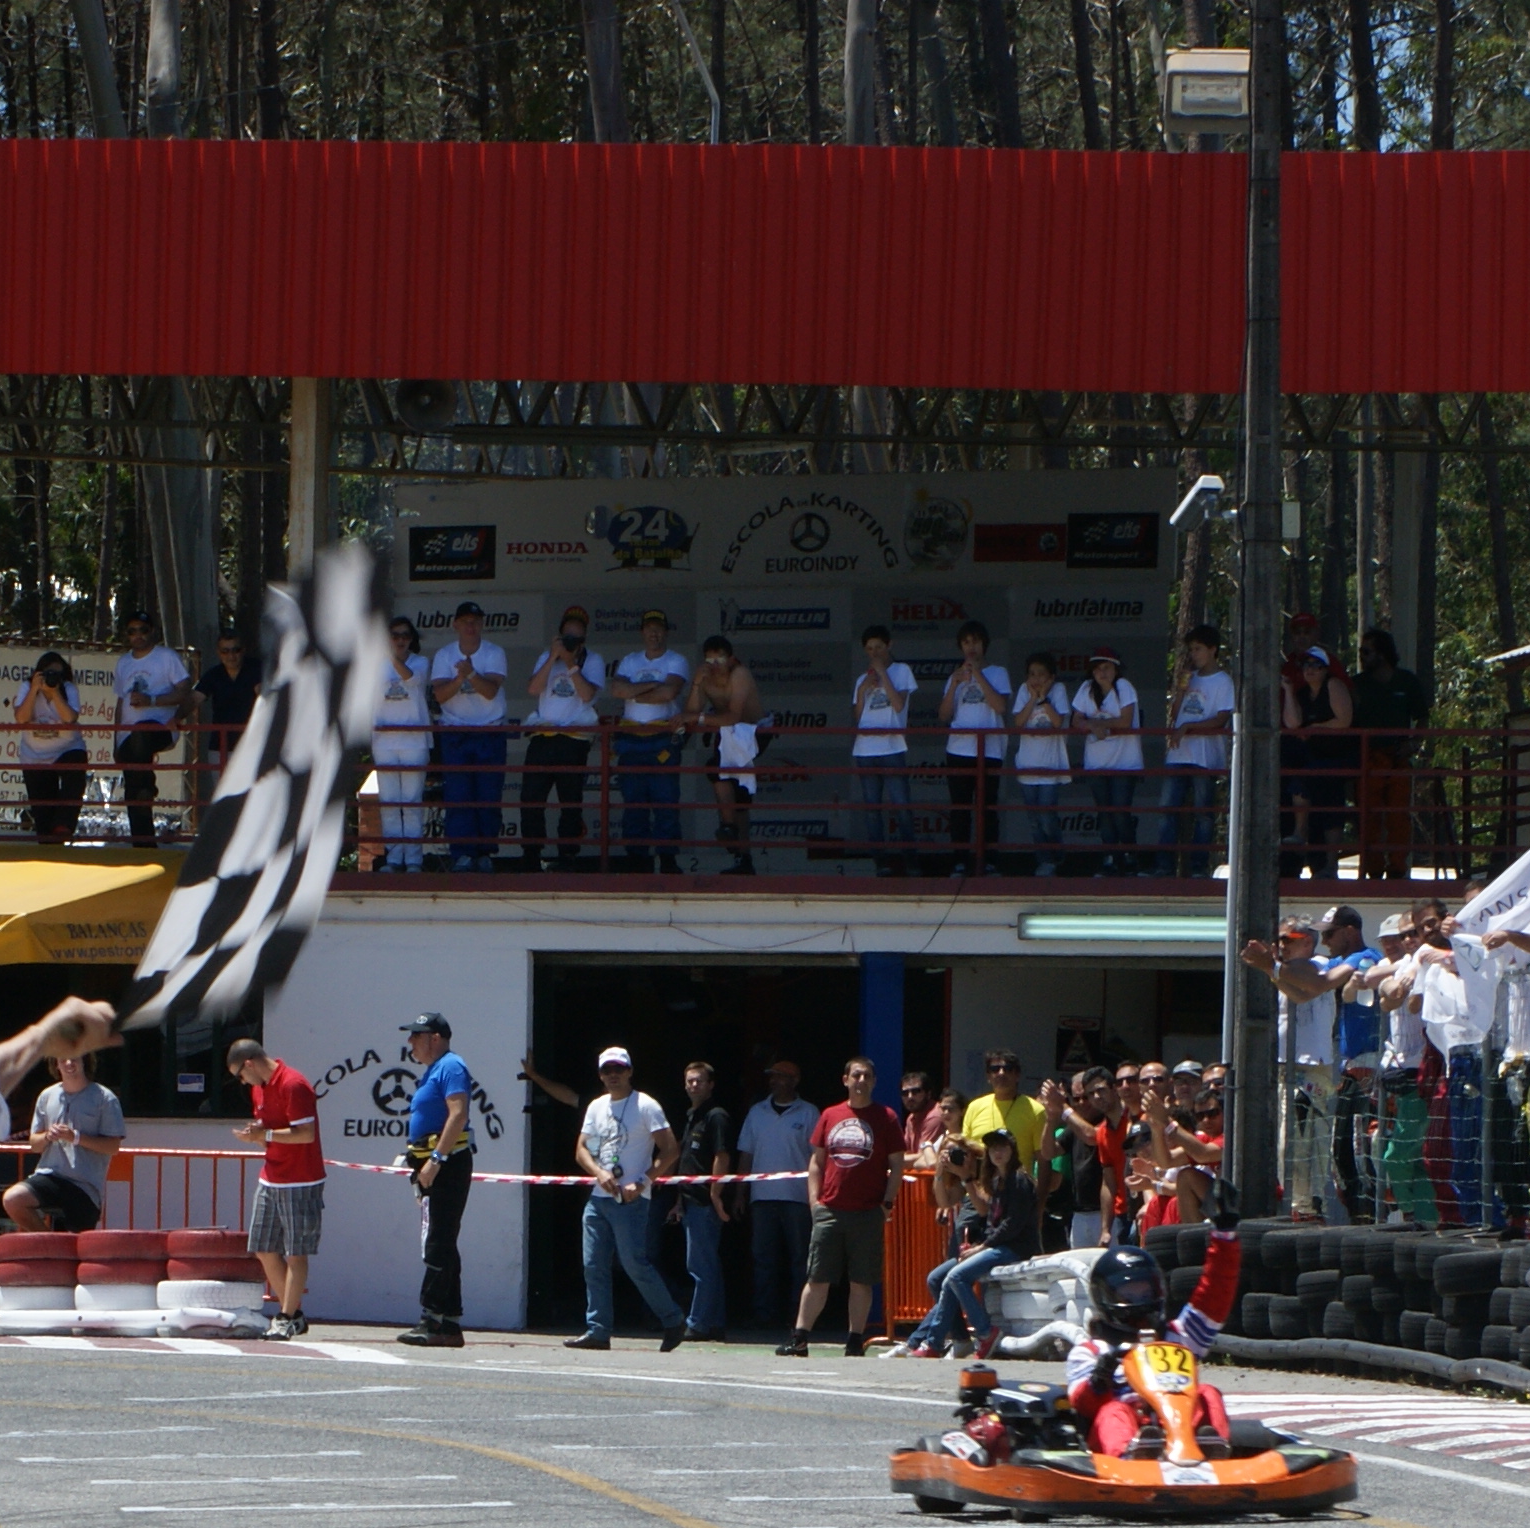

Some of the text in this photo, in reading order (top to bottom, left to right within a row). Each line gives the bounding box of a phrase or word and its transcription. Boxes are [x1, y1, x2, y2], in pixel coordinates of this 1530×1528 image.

[618, 510, 670, 543] 24
[721, 496, 794, 574] ESCOLA
[811, 492, 899, 569] KARTING
[506, 542, 588, 555] HONDA
[765, 555, 859, 573] EUROINDY
[741, 610, 827, 625] MICHELIN
[892, 602, 967, 620] HELIX
[690, 857, 698, 872] 2
[67, 921, 147, 942] BALANÇAS
[313, 1049, 382, 1099] COLA
